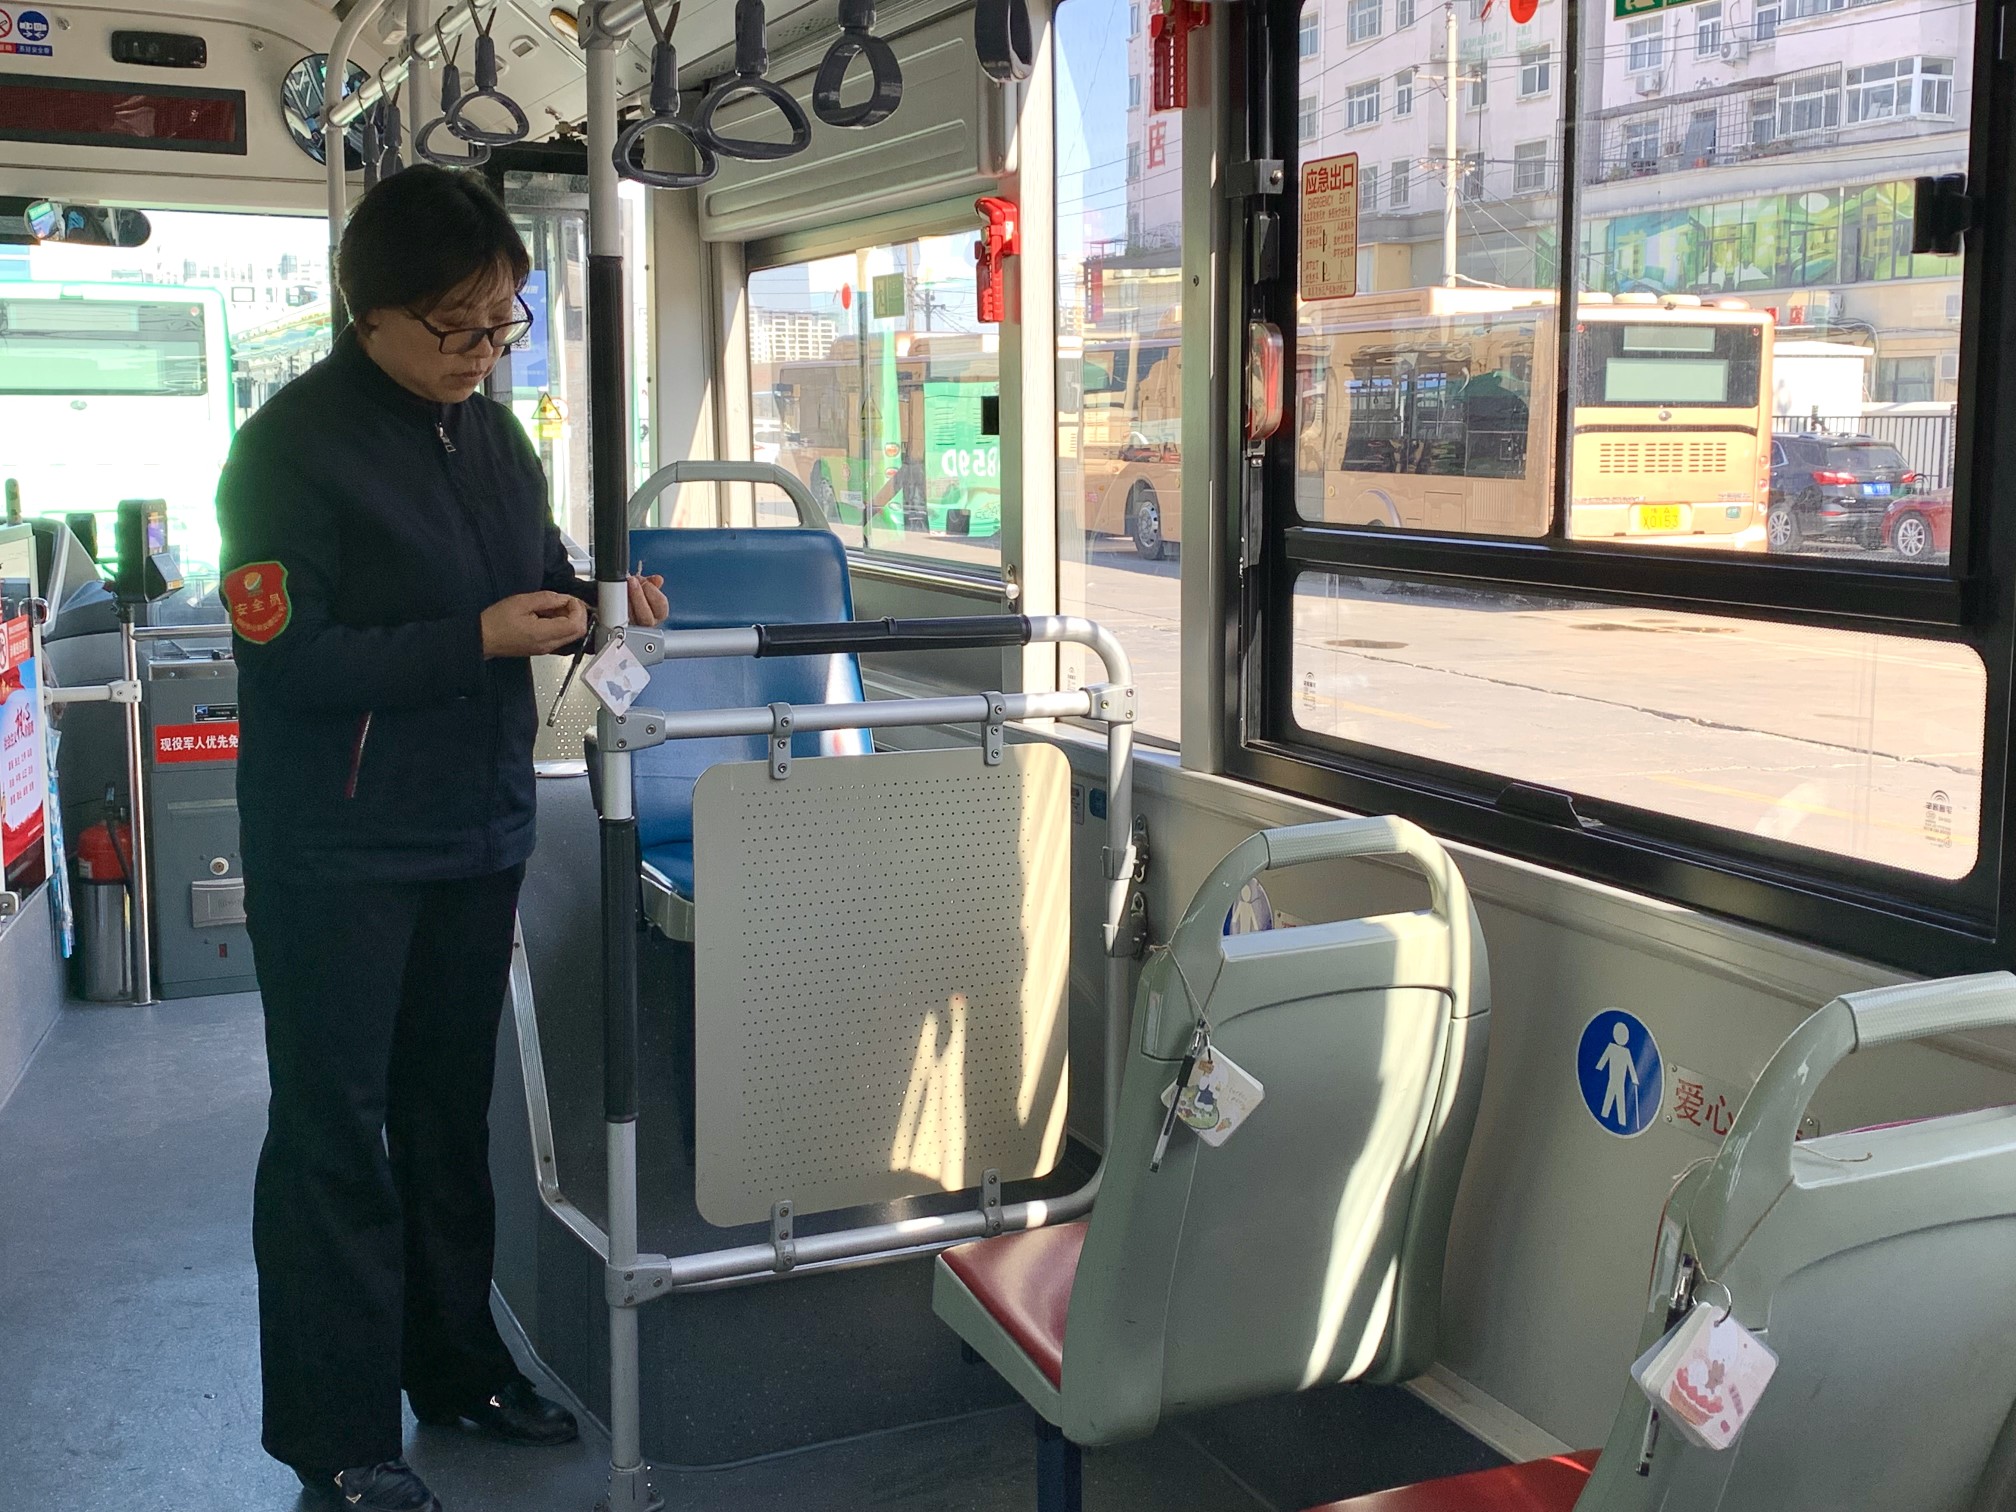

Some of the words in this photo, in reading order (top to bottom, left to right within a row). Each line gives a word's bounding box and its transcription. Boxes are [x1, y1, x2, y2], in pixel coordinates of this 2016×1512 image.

[1305, 163, 1354, 195] 应急出口
[1307, 195, 1334, 210] EMERGENCY
[1339, 191, 1351, 205] EXIT
[235, 593, 283, 617] 安全员
[160, 734, 239, 752] 现役军人优先免
